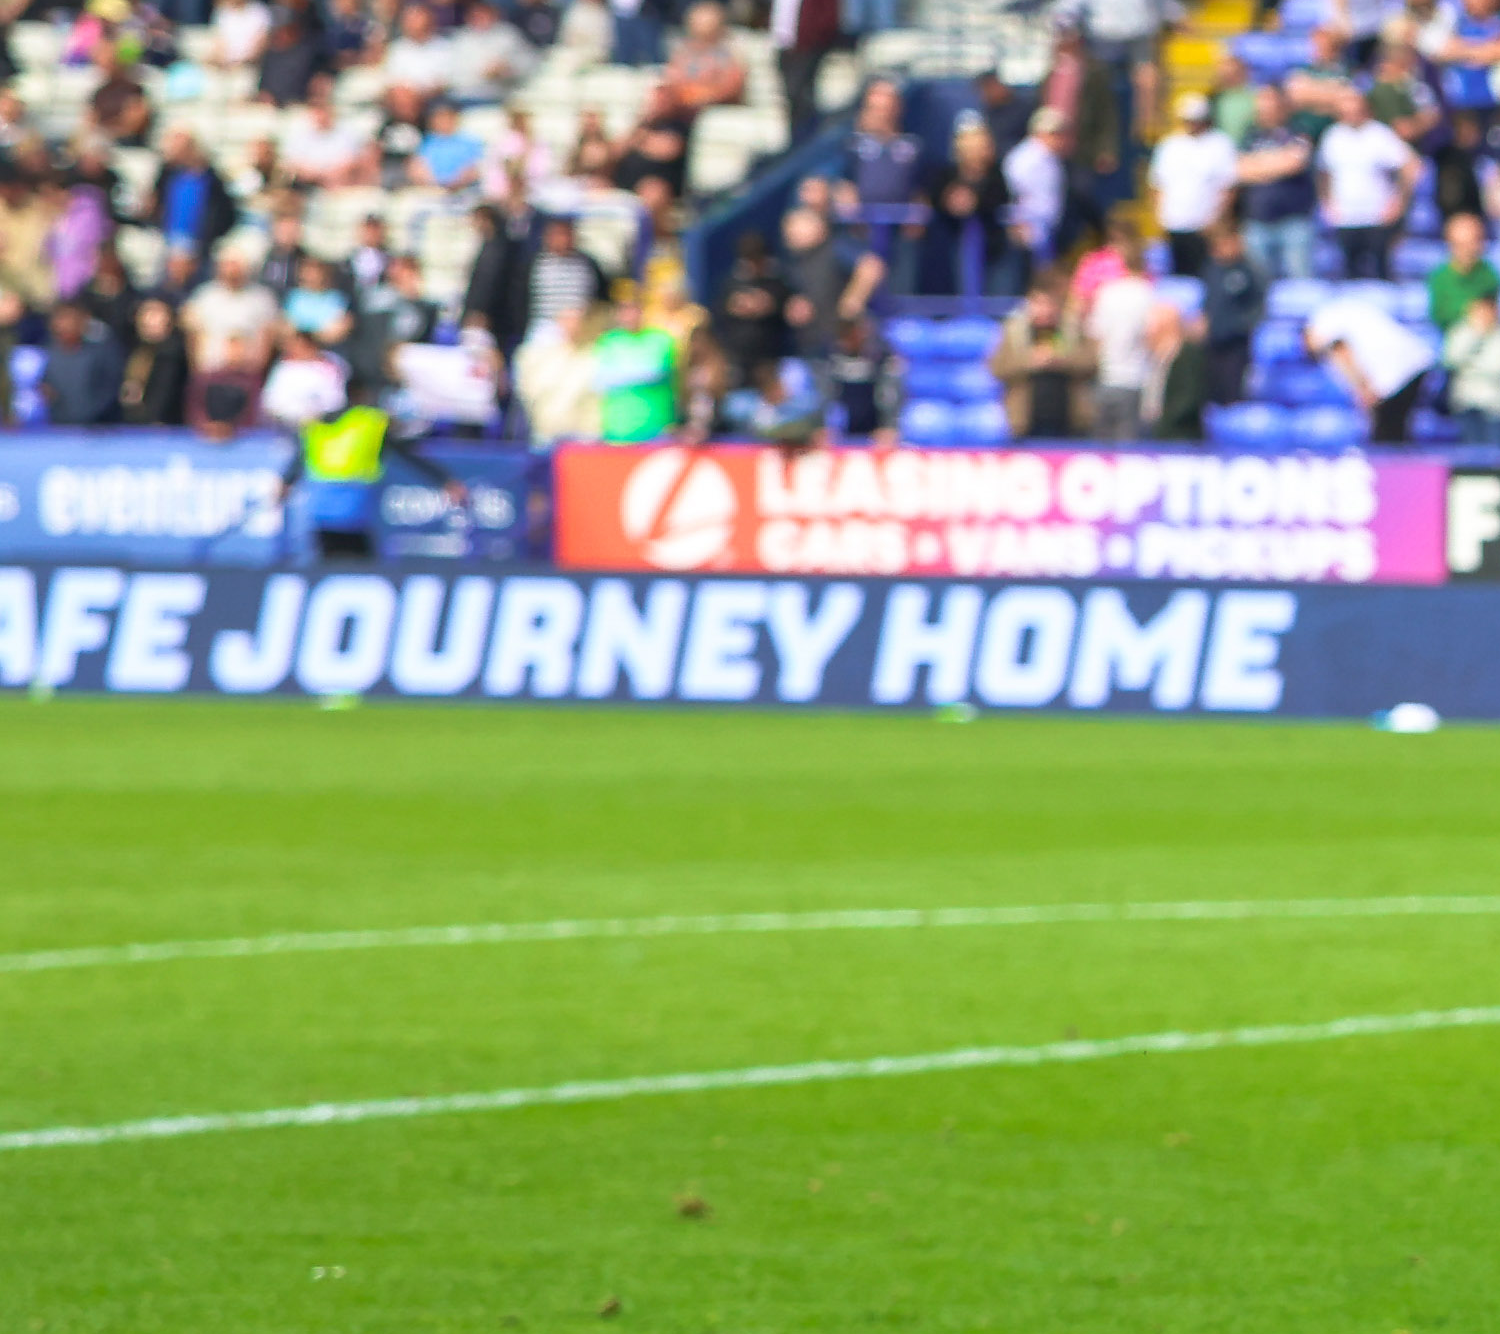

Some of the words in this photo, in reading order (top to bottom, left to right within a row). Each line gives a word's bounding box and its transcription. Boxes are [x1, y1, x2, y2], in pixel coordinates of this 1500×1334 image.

[755, 447, 1053, 521] LEASING
[1056, 449, 1377, 526] OPTIONS
[0, 567, 206, 692] AFE
[209, 570, 866, 700] JOURNEY
[872, 585, 1296, 711] HOME
